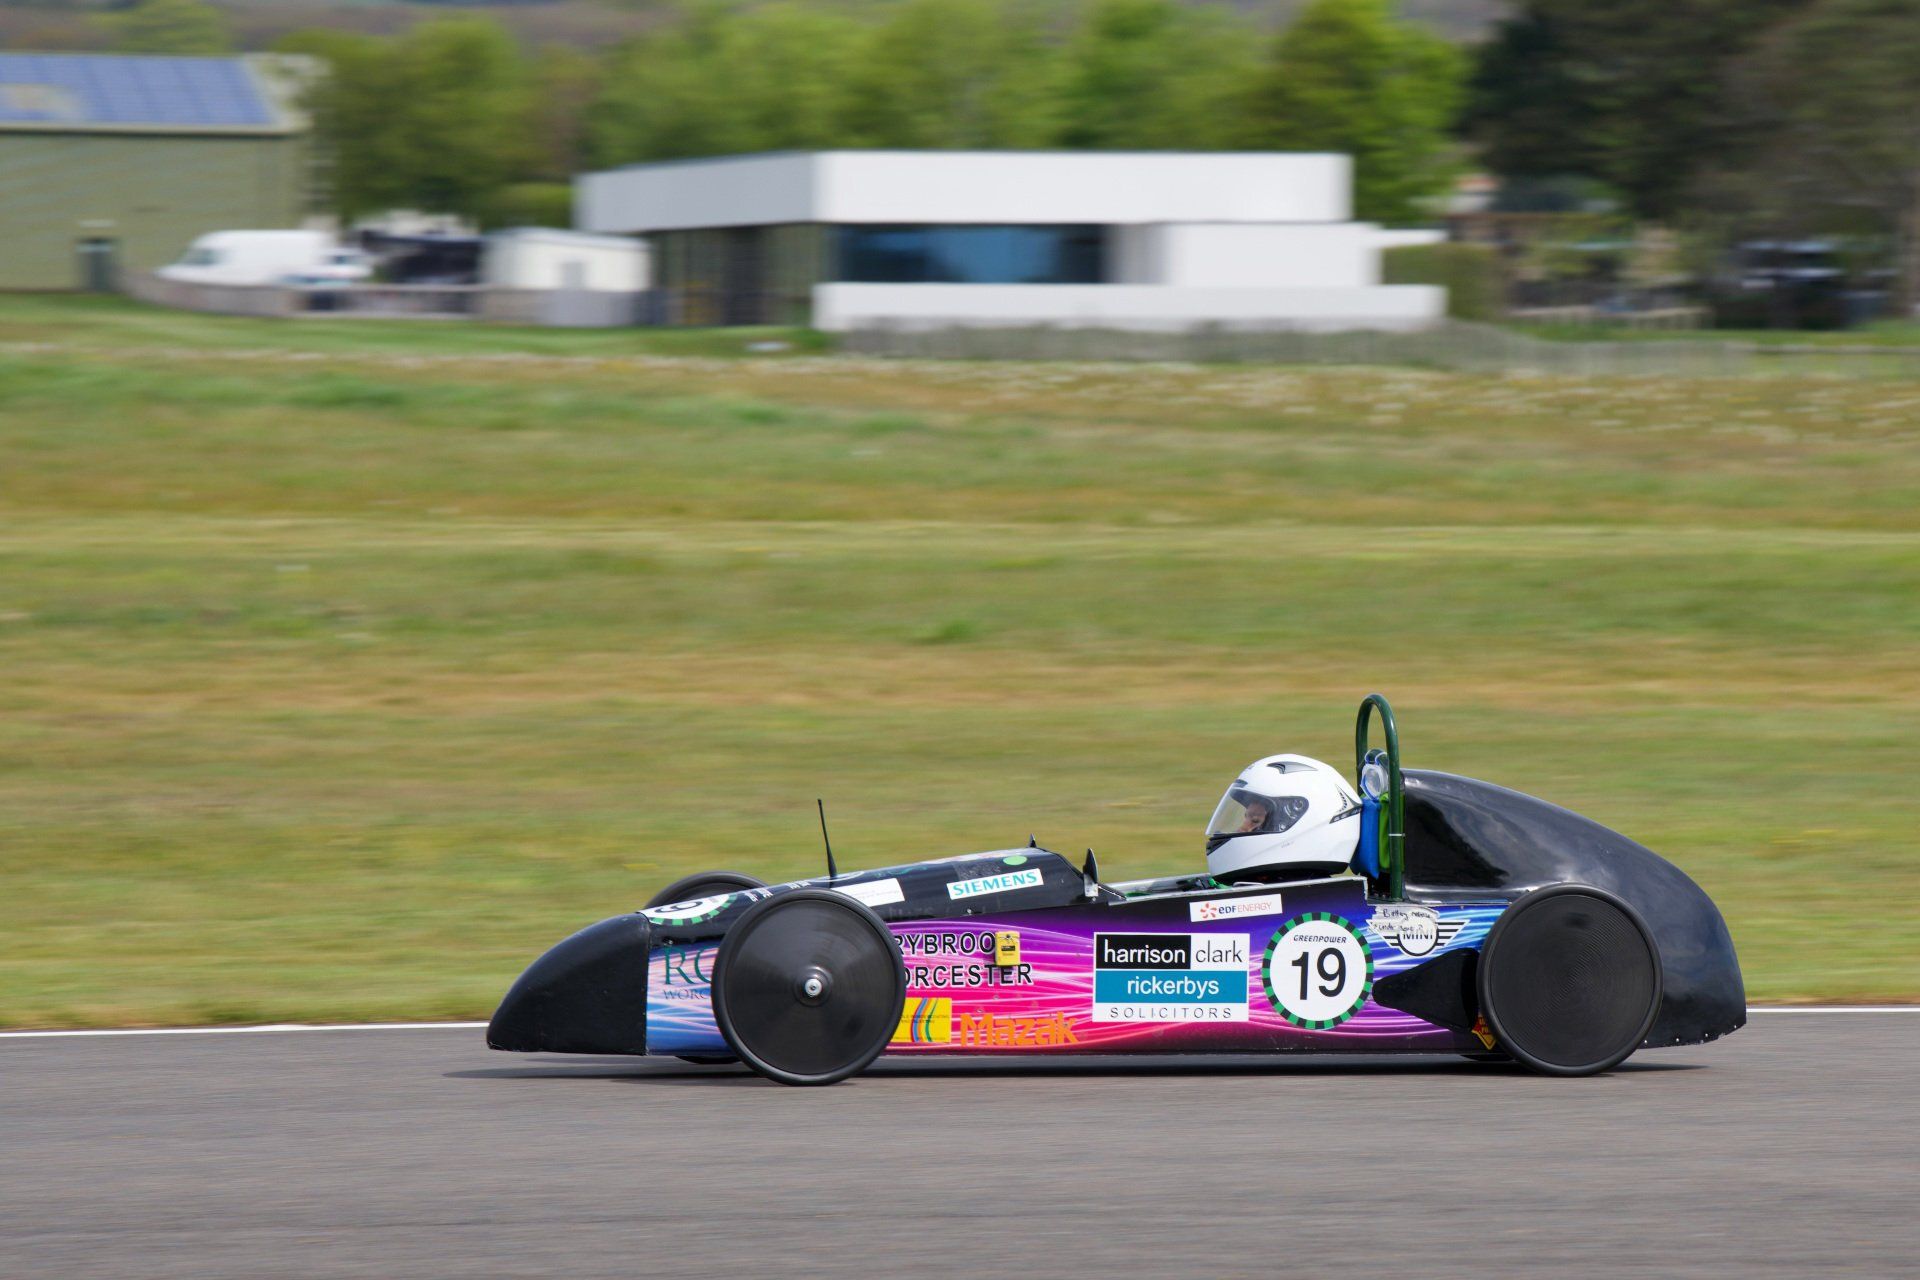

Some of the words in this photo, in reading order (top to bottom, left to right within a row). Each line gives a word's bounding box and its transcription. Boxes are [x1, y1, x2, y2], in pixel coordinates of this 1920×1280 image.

[953, 871, 1038, 896] SIEMENS
[1237, 902, 1272, 913] ENERGY
[1293, 934, 1347, 943] GREENPOWER
[1104, 939, 1186, 963] harrison
[1195, 940, 1243, 963] clark
[1291, 947, 1347, 1000] 19
[1127, 976, 1220, 999] rickerbys
[1110, 1007, 1232, 1019] SOLICITORS
[960, 1011, 1079, 1047] Mazak
